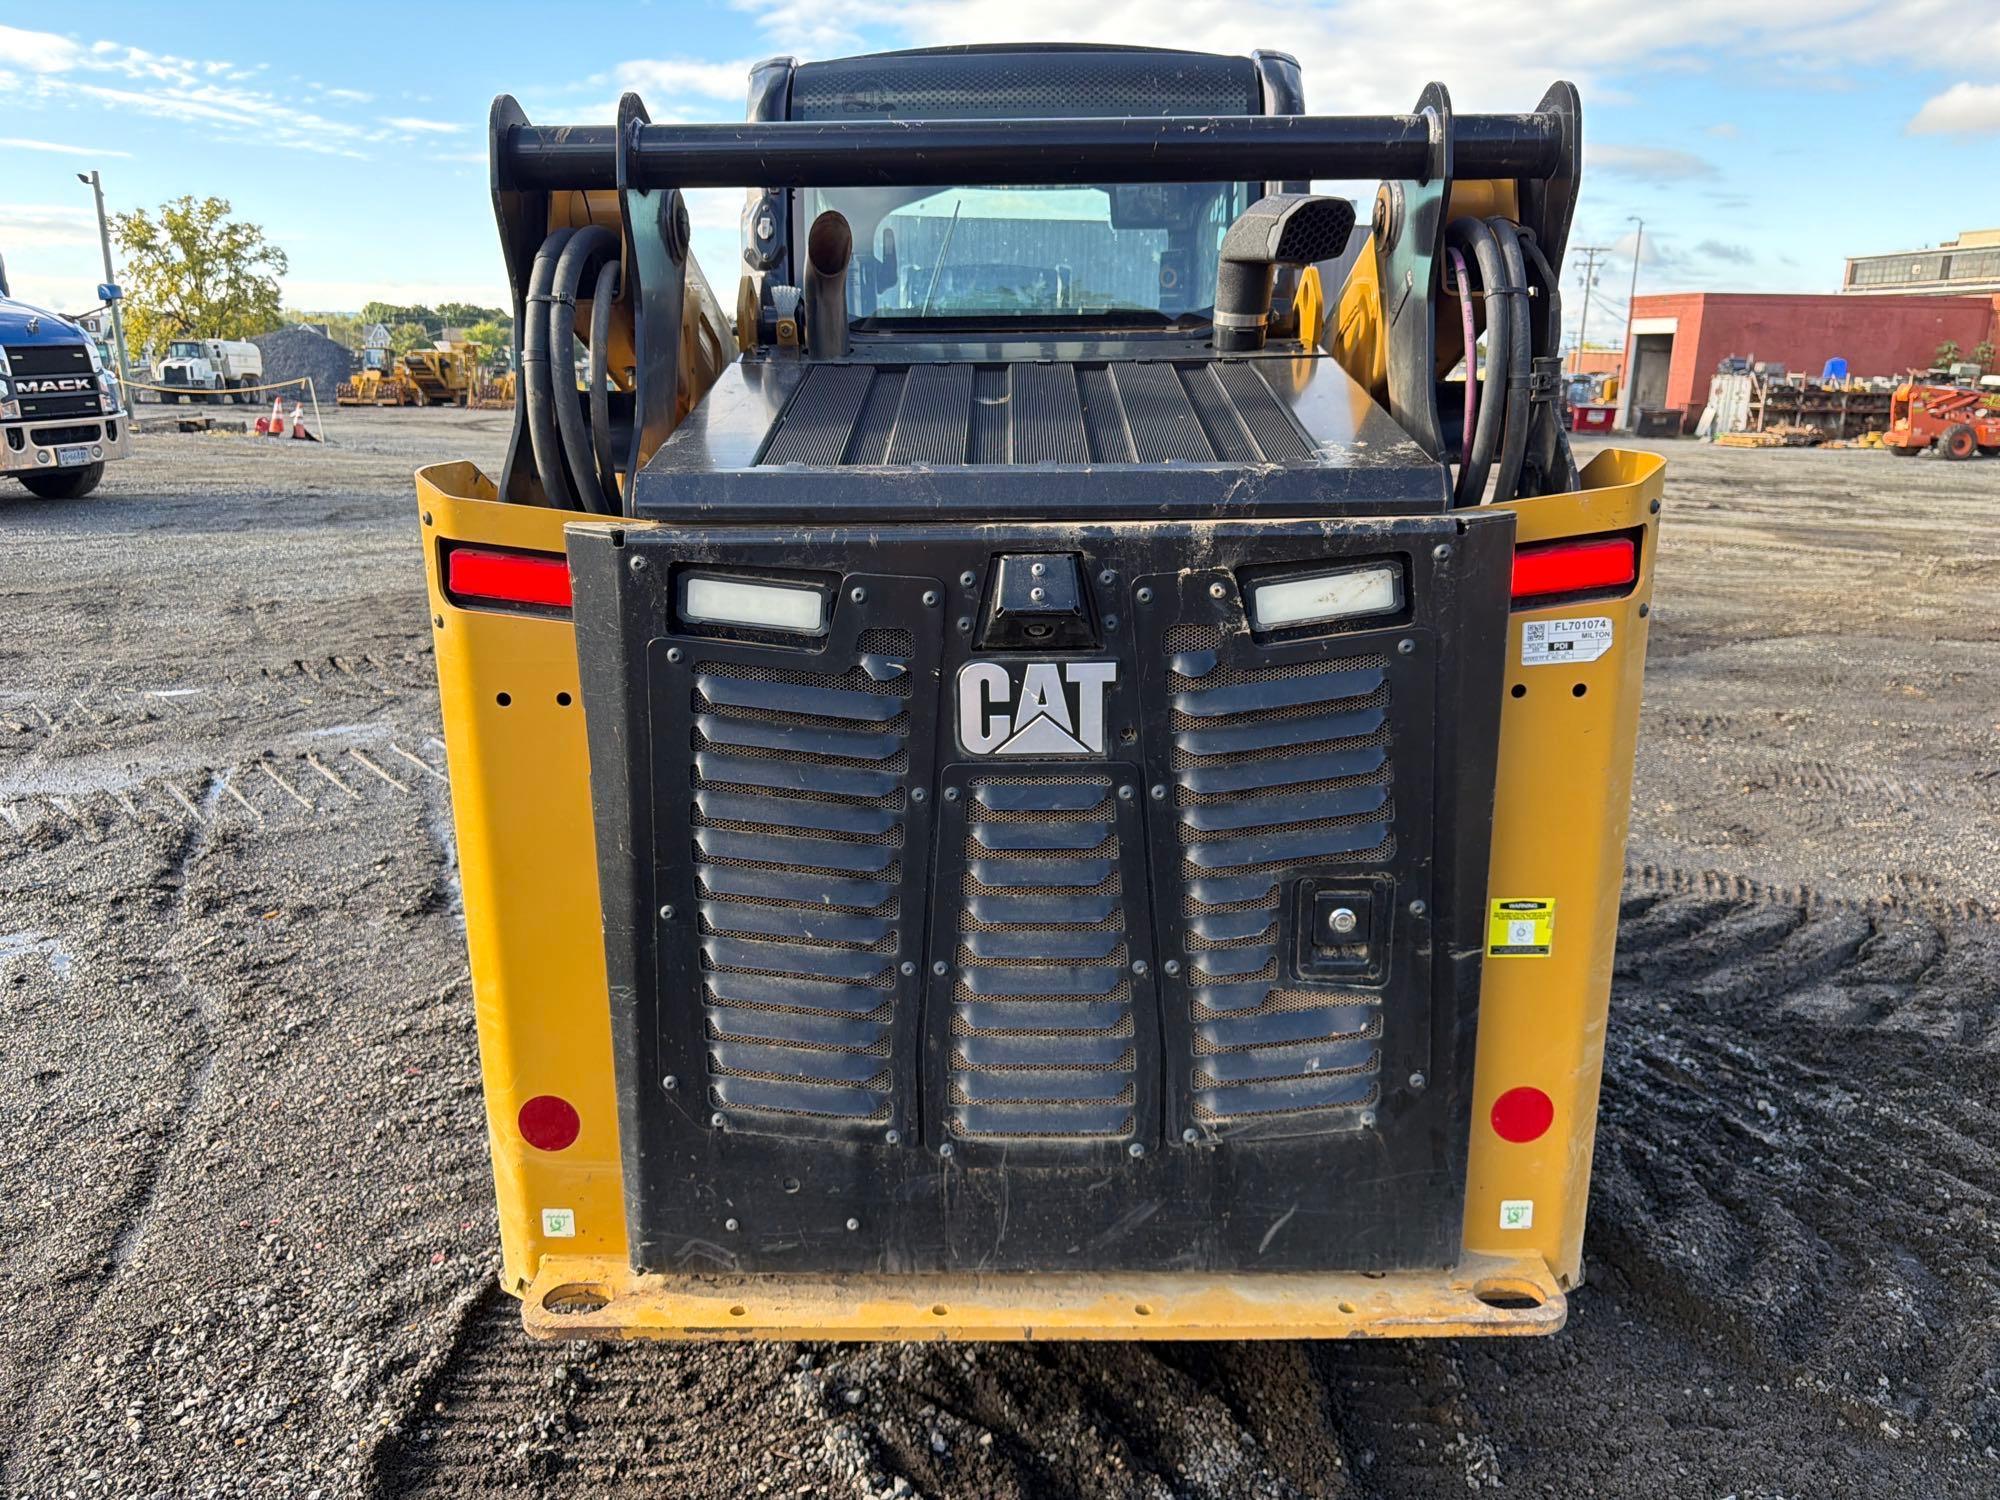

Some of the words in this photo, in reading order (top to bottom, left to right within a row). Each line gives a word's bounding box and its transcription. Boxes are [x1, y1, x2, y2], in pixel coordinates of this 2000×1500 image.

[16, 378, 91, 392] MACK
[1554, 619, 1606, 631] FL701074
[1581, 631, 1610, 639] MILTON
[1553, 642, 1568, 650] PDI
[959, 662, 1117, 754] CAT
